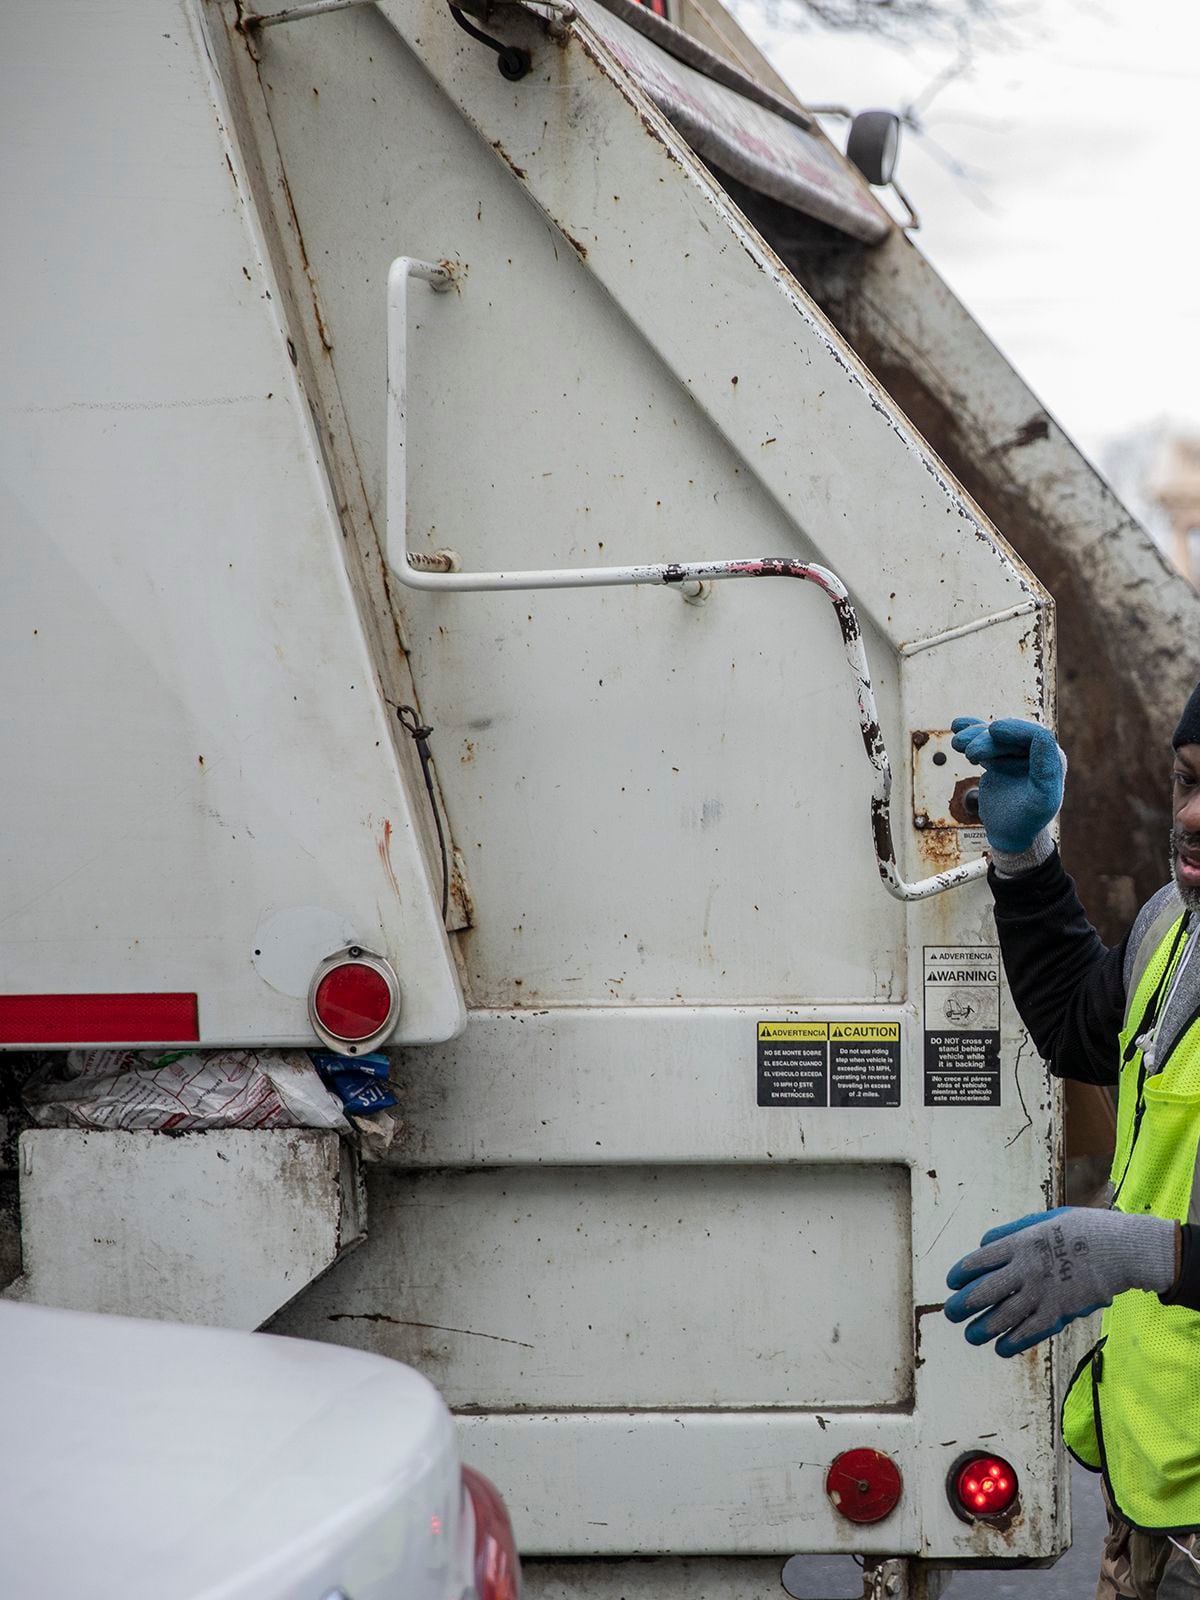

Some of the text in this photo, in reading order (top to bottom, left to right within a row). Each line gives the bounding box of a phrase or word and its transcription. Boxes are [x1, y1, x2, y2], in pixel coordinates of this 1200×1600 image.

[939, 952, 992, 960] ADVERTENCIA
[938, 970, 996, 982] WARNING
[844, 1026, 896, 1037] CAUTION
[955, 1060, 985, 1068] backing!
[1052, 1225, 1074, 1282] HyFlex
